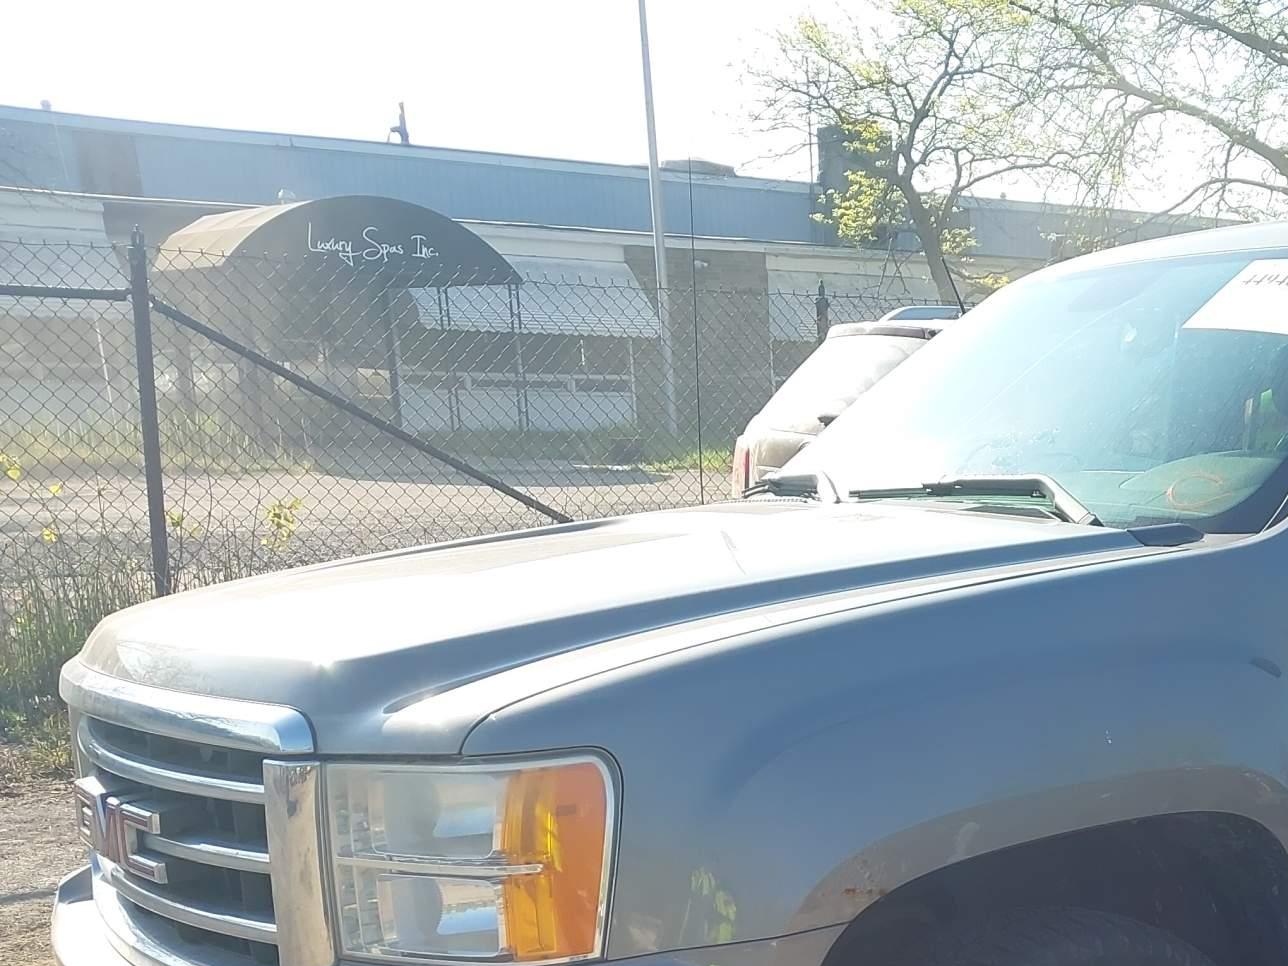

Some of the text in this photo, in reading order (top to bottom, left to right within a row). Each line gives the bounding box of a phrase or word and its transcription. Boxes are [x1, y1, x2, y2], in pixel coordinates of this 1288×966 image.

[307, 221, 439, 267] Luxury Spas Inc.
[73, 776, 168, 884] GMC
